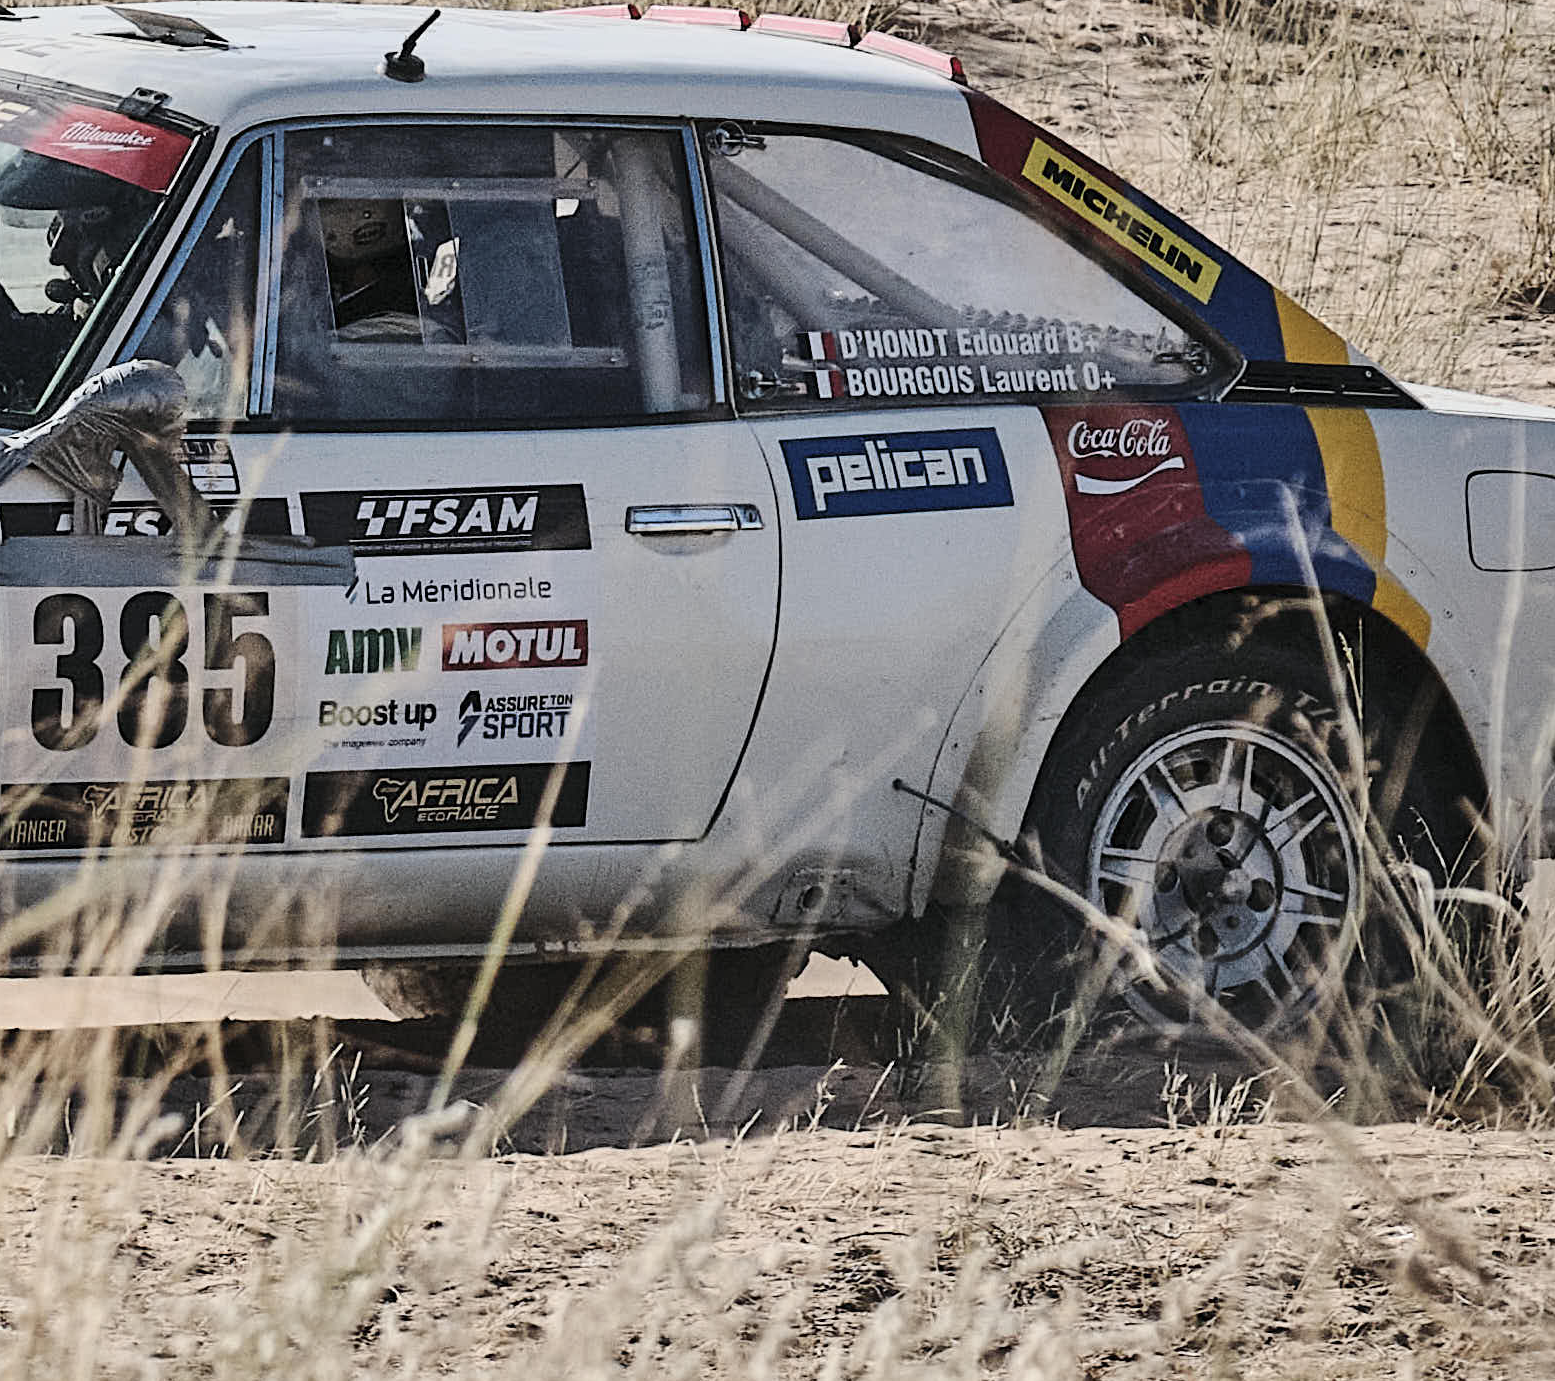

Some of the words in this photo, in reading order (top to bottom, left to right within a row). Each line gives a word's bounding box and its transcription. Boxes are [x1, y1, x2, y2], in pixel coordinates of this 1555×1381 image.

[60, 121, 156, 147] Milwaukee
[1042, 158, 1204, 284] MICHELIN
[840, 329, 948, 360] D'HONDT
[956, 326, 1060, 357] Edouard
[1067, 326, 1100, 354] B+
[846, 366, 974, 397] BOURGOIS
[980, 364, 1078, 394] Laurent
[1068, 419, 1172, 458] Coca-Cola
[806, 441, 987, 512] pelican
[365, 582, 395, 604] La
[402, 576, 552, 603] Méridionale
[448, 627, 582, 665] MOTUL
[31, 590, 276, 751] 385
[319, 699, 398, 727] Boost
[404, 701, 437, 732] up
[484, 695, 547, 713] ASSURE
[550, 693, 573, 706] TON
[482, 711, 572, 739] SPORT
[1076, 676, 1276, 811] All-Terrain
[390, 776, 519, 813] AFRICA
[10, 819, 67, 844] TANGER
